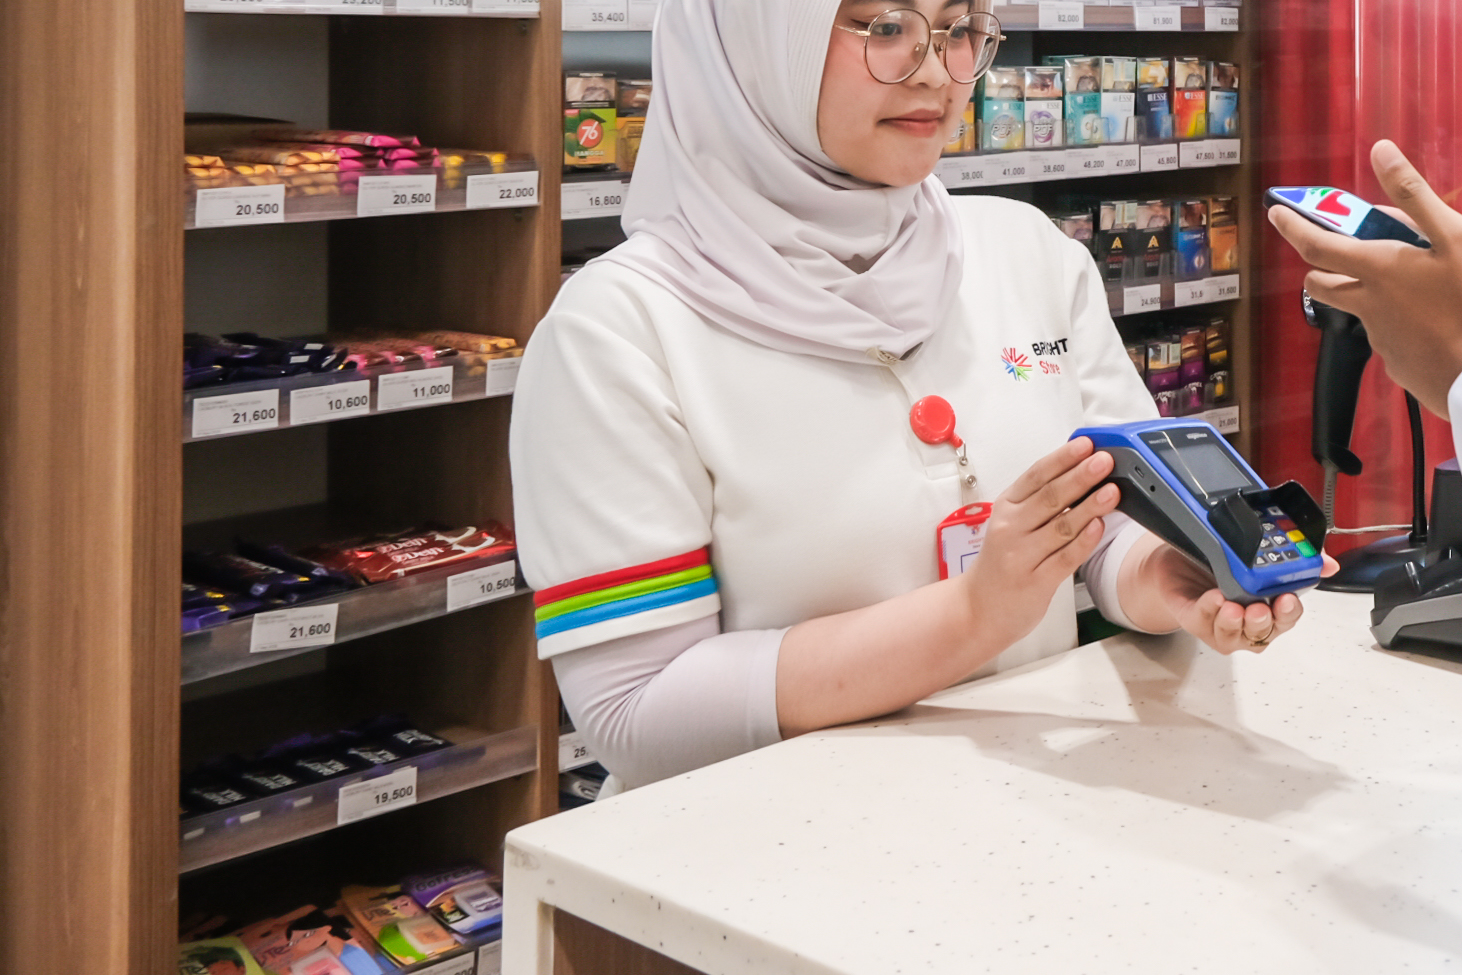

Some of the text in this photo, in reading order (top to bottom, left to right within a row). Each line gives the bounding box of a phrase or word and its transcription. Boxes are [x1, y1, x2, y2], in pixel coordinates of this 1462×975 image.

[592, 13, 625, 22] 35,400
[1058, 14, 1079, 23] 82,000
[580, 121, 598, 145] 76
[1003, 167, 1025, 176] 41,000
[1043, 165, 1064, 173] 38,600
[393, 193, 431, 205] 20,500
[499, 187, 534, 199] 22,000
[589, 196, 621, 206] 16,800
[236, 202, 279, 216] 20,500
[412, 383, 450, 398] 11,000
[327, 395, 368, 411] 10,600
[232, 408, 276, 424] 21,600
[480, 577, 516, 594] 10,500
[290, 622, 331, 639] 21,600
[374, 785, 413, 805] 19,500
